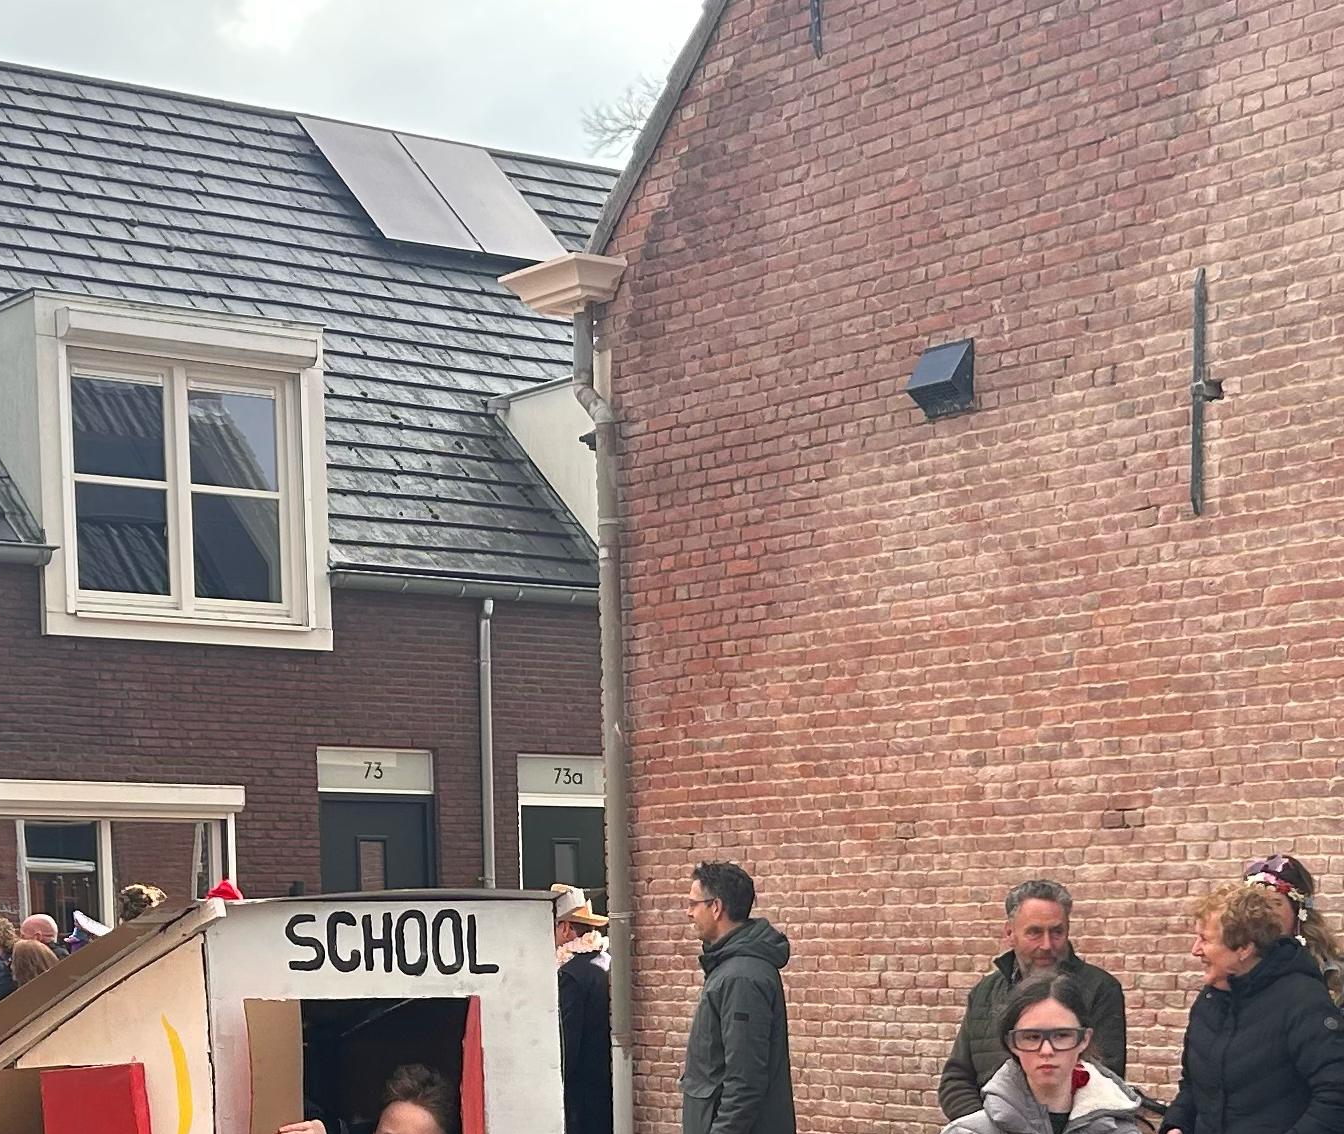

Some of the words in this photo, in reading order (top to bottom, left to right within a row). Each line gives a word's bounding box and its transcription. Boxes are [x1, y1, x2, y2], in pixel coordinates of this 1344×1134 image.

[363, 761, 384, 780] 73
[553, 767, 584, 786] 73a
[285, 908, 500, 977] SCHOOL
